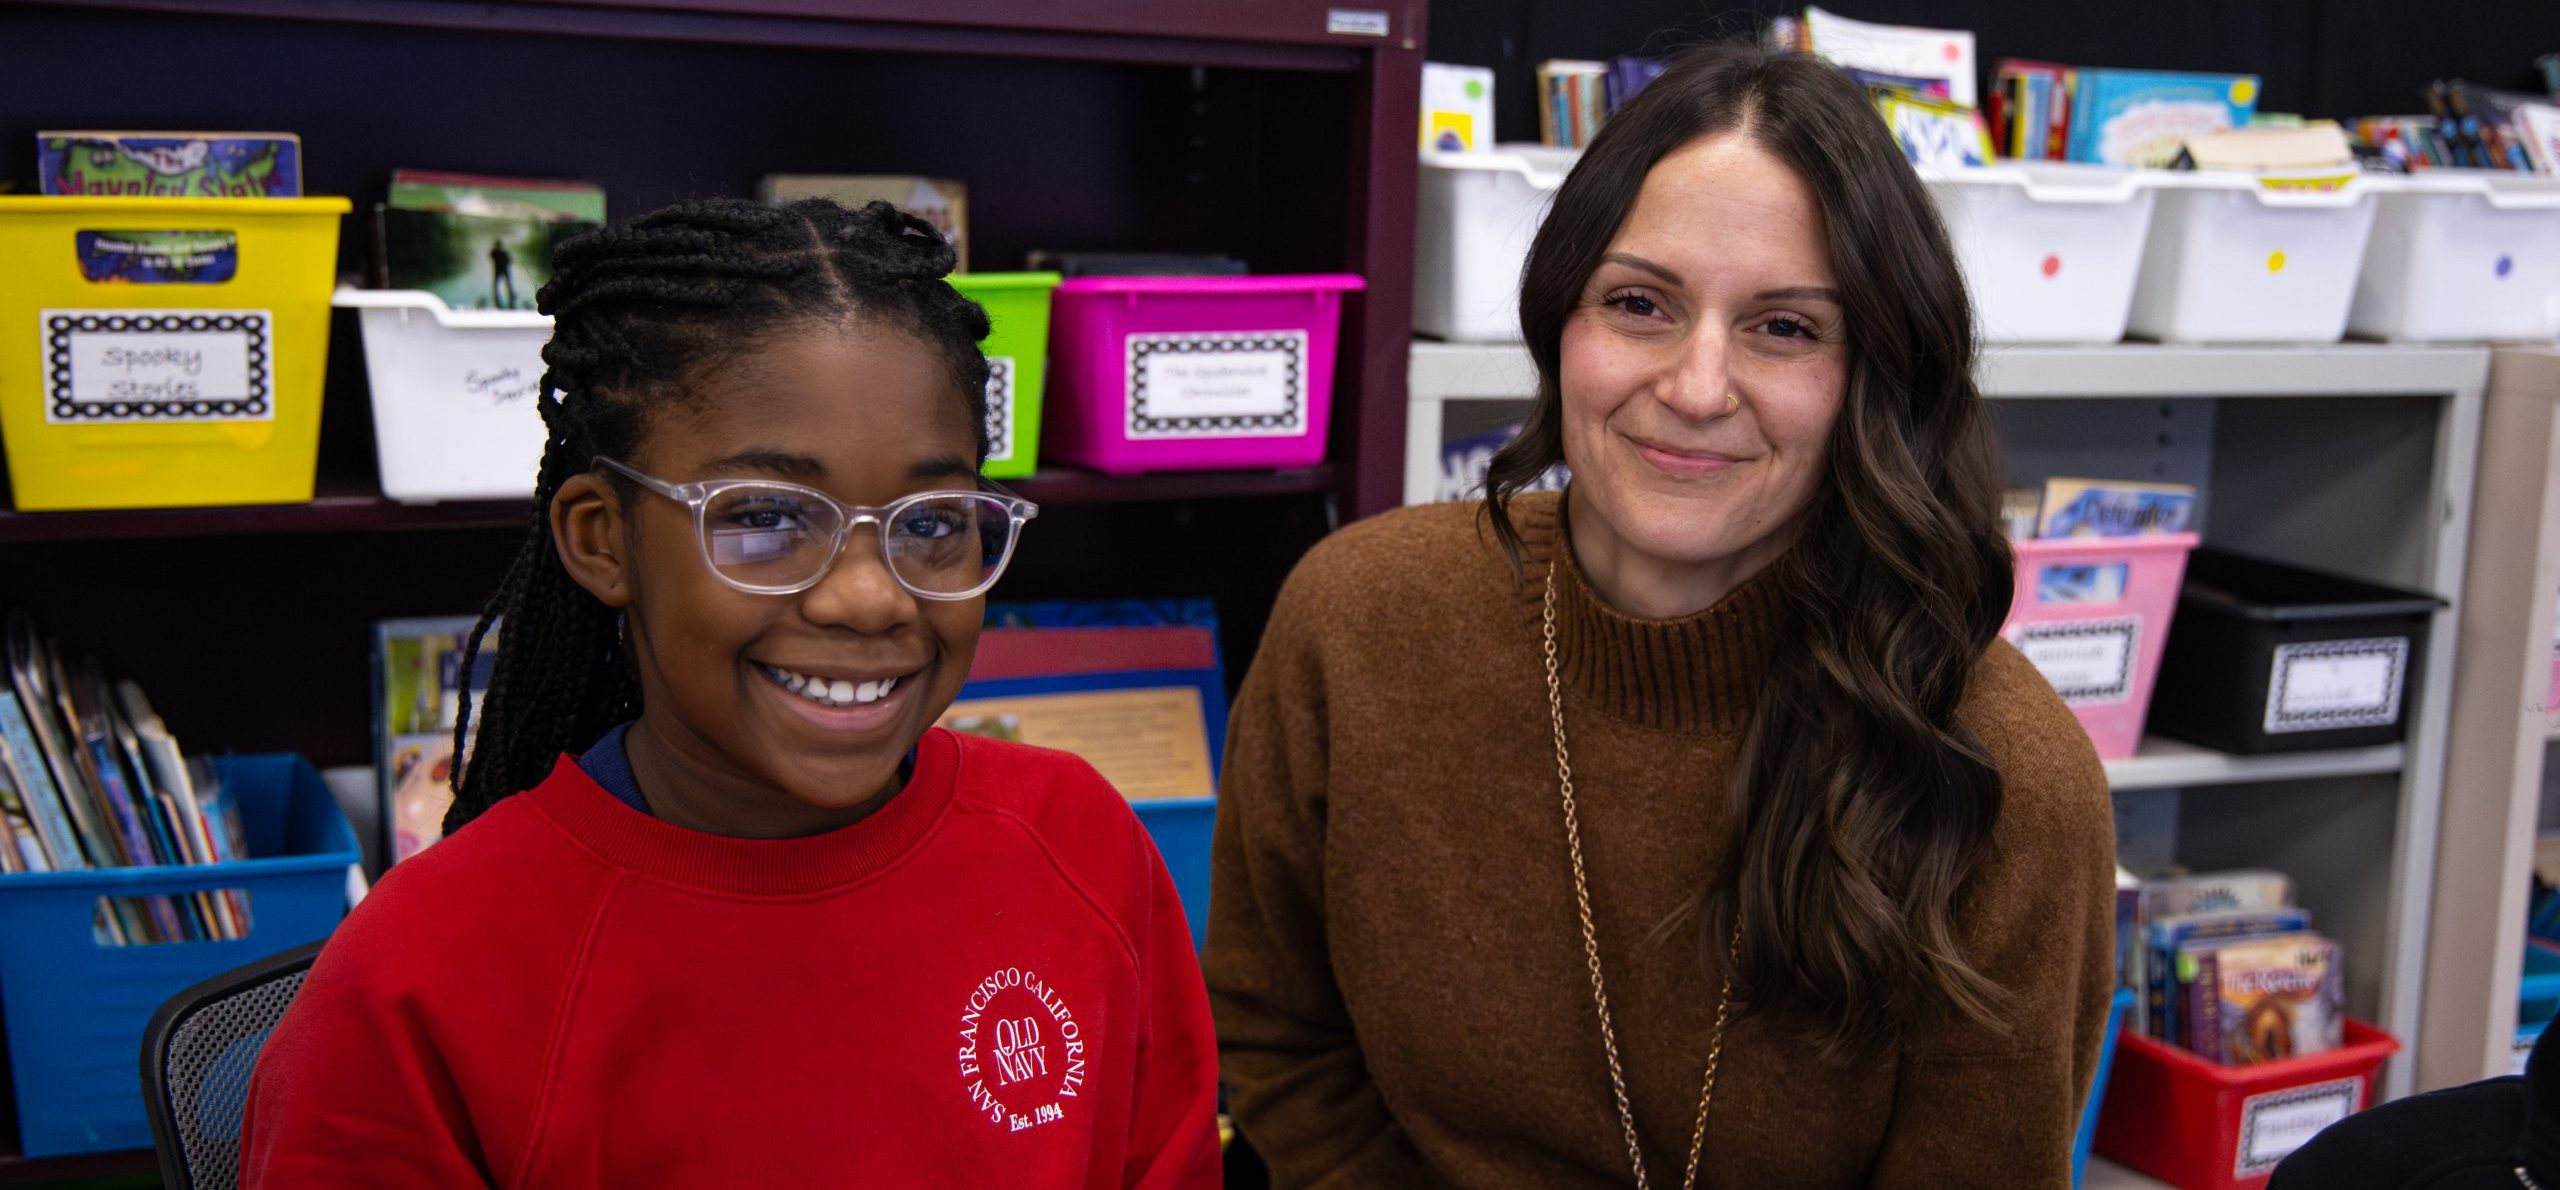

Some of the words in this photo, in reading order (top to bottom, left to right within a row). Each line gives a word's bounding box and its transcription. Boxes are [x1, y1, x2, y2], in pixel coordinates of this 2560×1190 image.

[100, 345, 203, 377] Spooky
[107, 377, 200, 401] Stories
[959, 967, 1020, 1077] FRANCISCO
[995, 1016, 1040, 1055] OLD
[1024, 971, 1085, 1098] CALIFORNIA
[993, 1045, 1048, 1086] NAVY
[967, 1079, 1006, 1123] SAN
[1009, 1113, 1033, 1132] Est.
[1035, 1102, 1064, 1125] 1994
